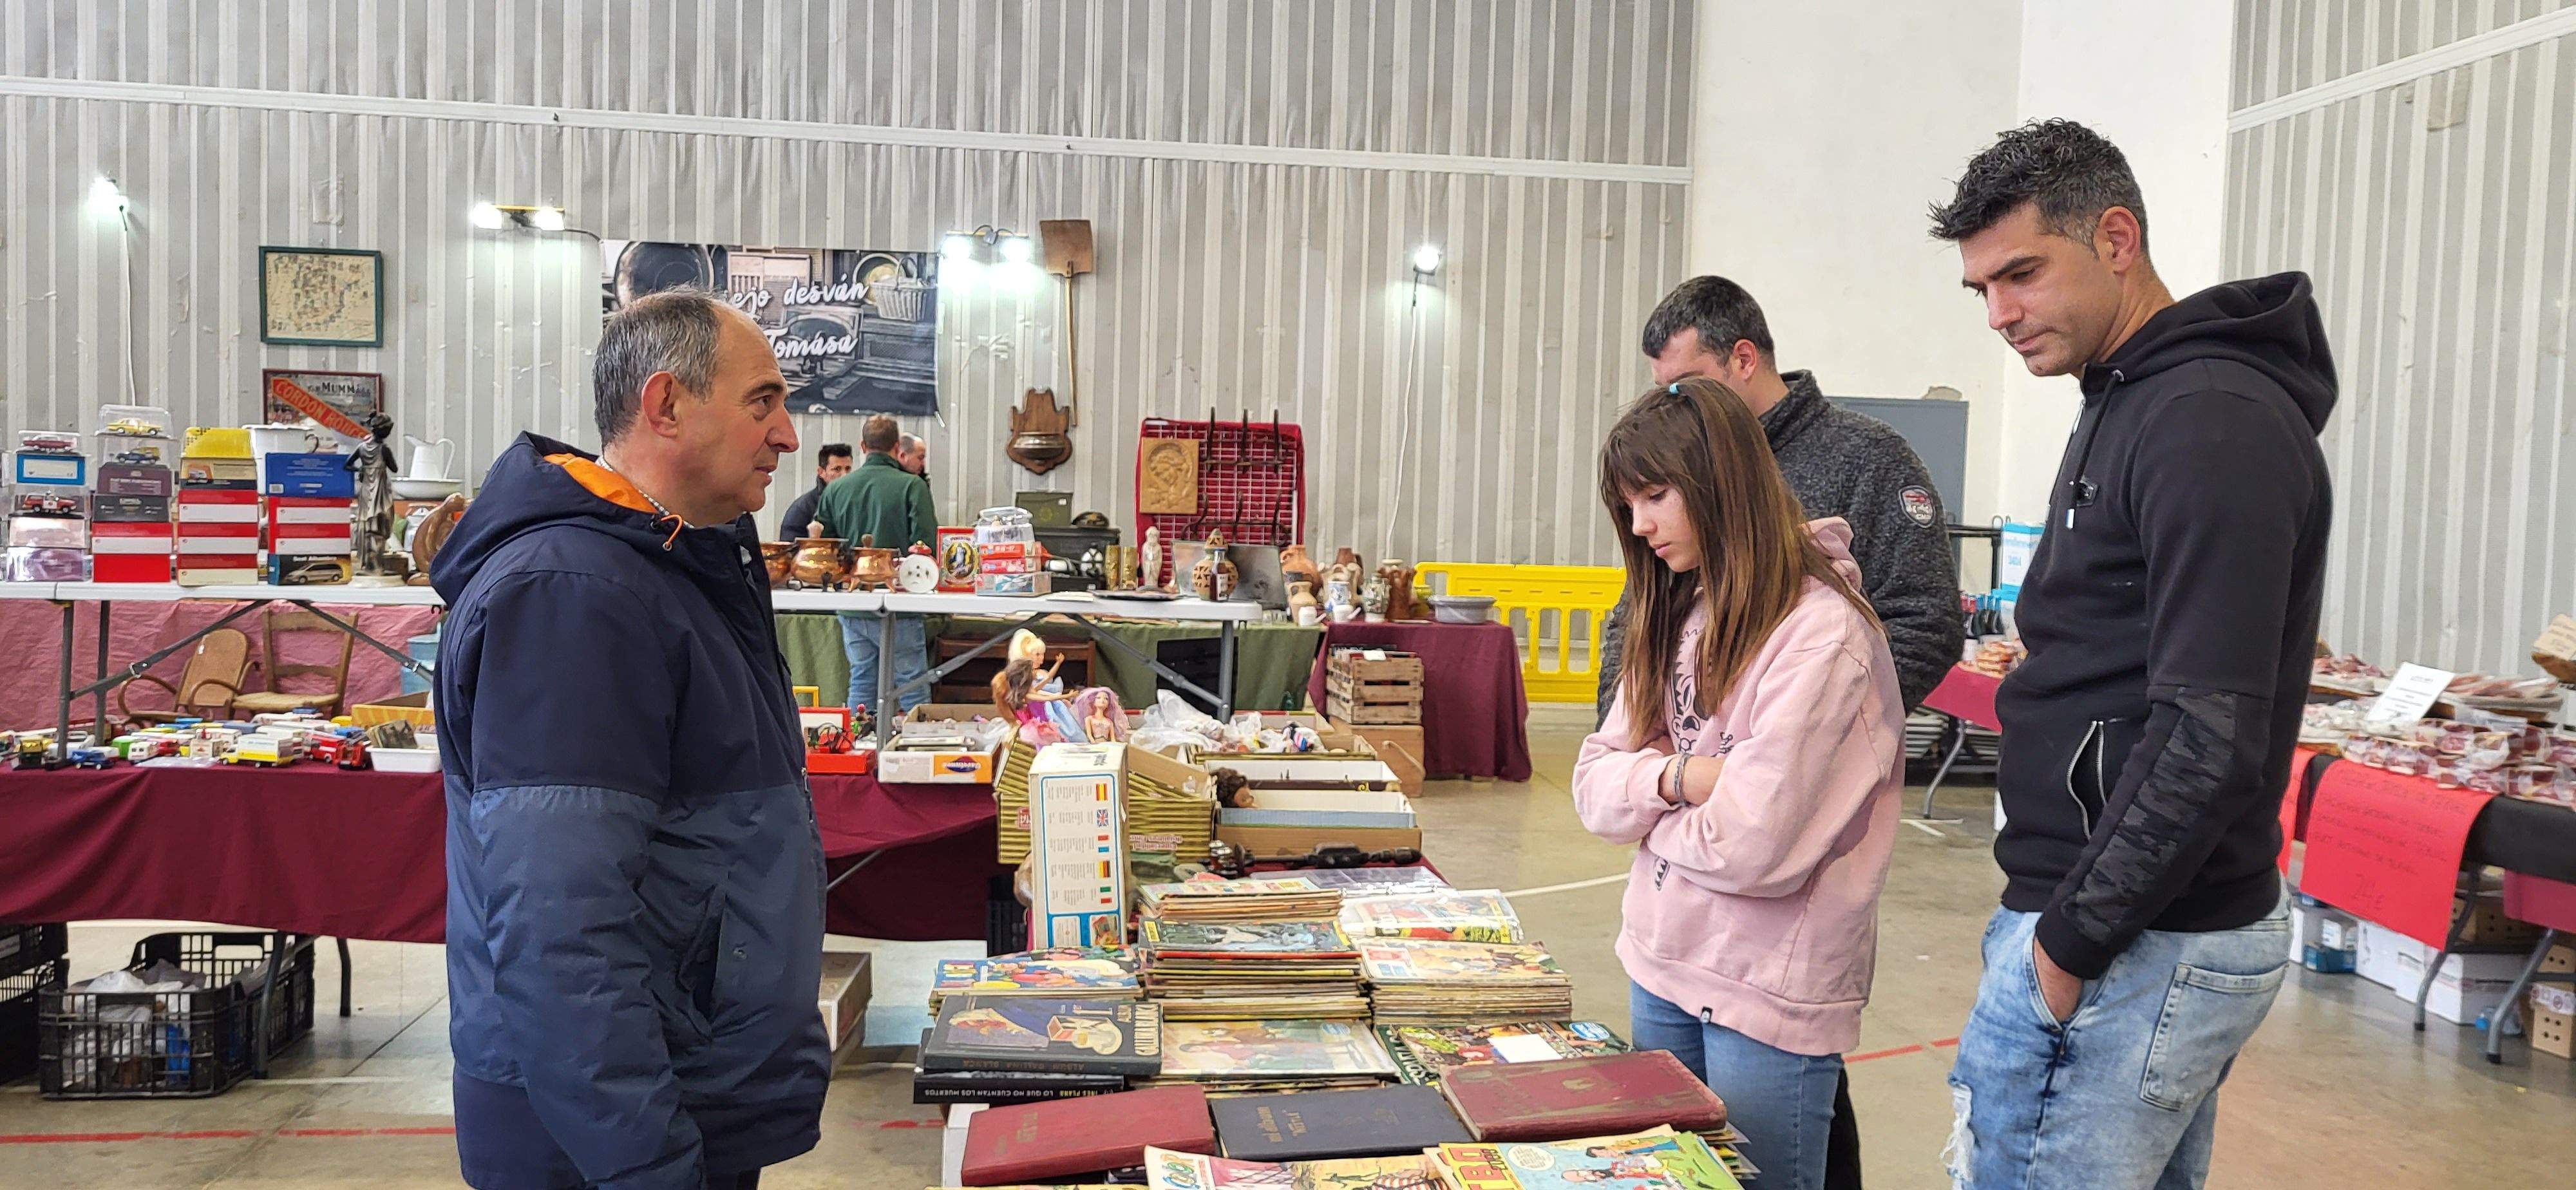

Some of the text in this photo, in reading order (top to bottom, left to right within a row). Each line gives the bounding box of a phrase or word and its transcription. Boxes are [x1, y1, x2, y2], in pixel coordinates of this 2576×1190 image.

[784, 274, 869, 305] desván
[763, 326, 858, 359] Tomása
[275, 380, 327, 421] CORDON
[978, 1089, 1012, 1097] CUENTAN
